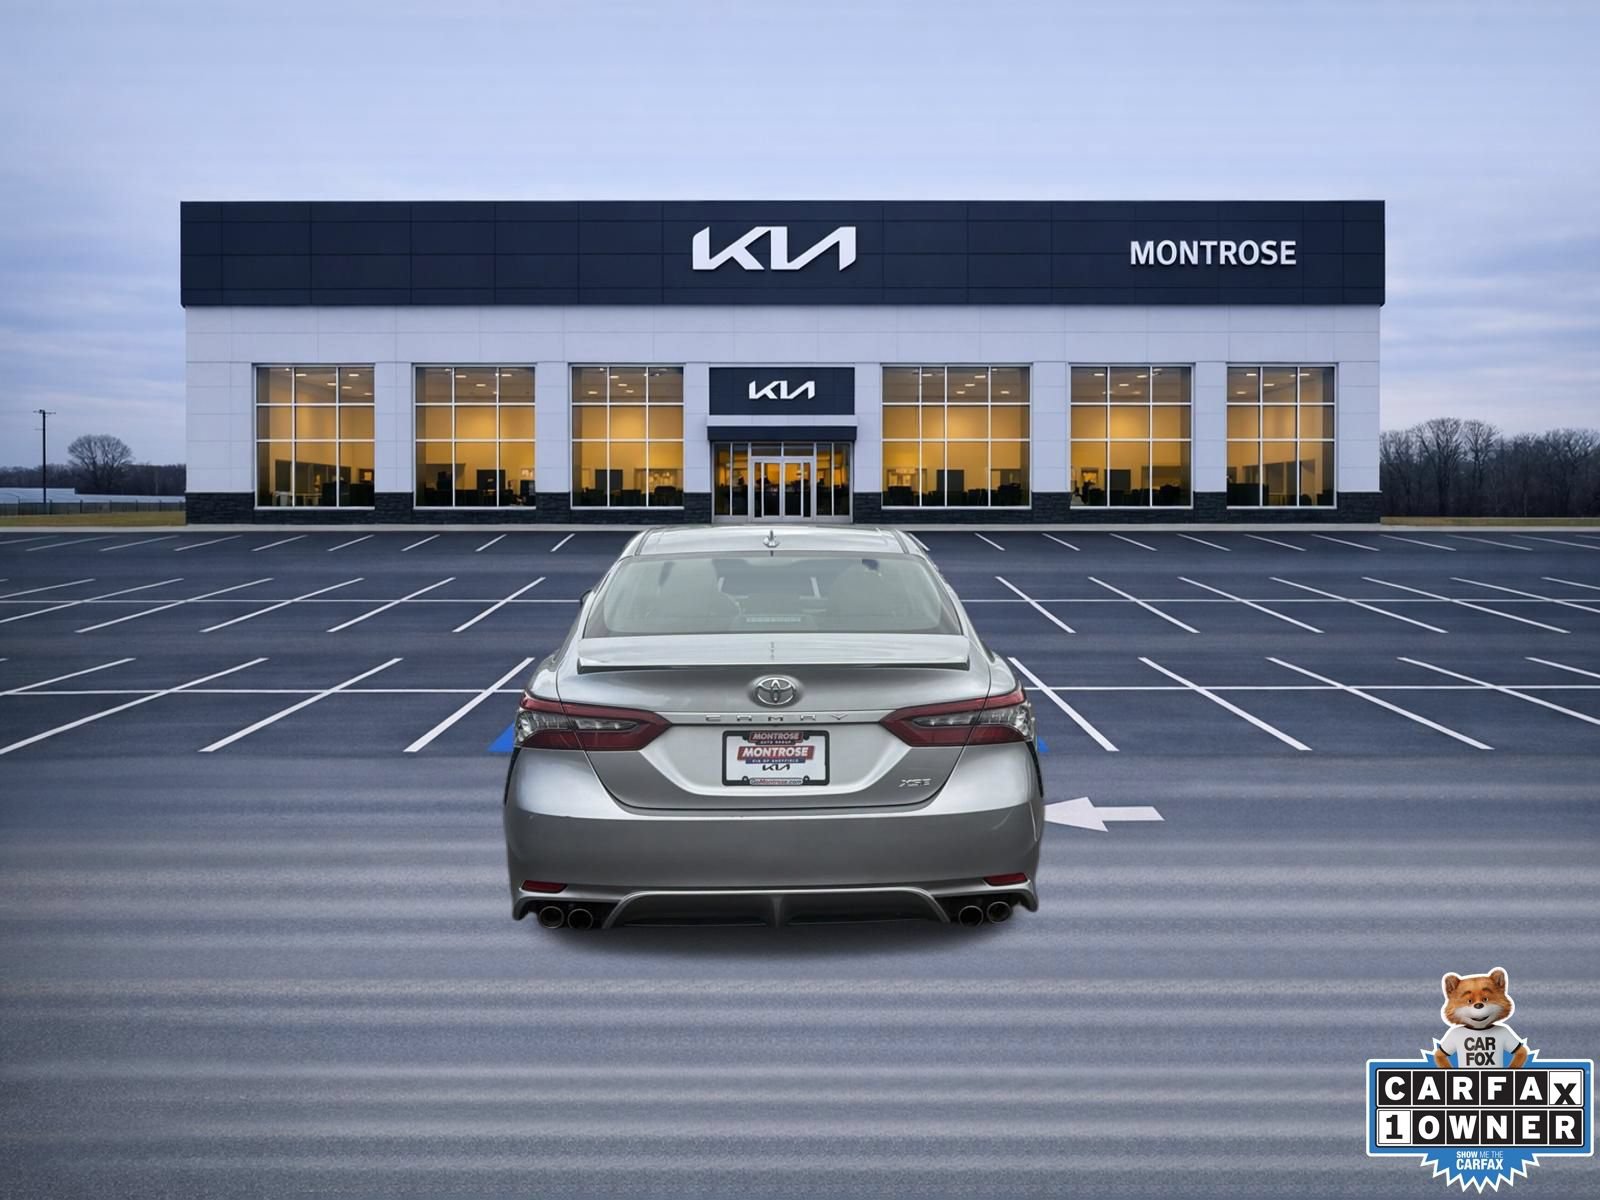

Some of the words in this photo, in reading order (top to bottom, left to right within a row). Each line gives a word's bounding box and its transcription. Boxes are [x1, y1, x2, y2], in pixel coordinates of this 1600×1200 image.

[692, 226, 857, 271] KIA
[1130, 240, 1297, 267] MONTROSE
[748, 380, 815, 400] KIA
[705, 713, 848, 722] CAMRY
[752, 732, 800, 740] MONTROSE
[742, 747, 809, 757] MONTROSE
